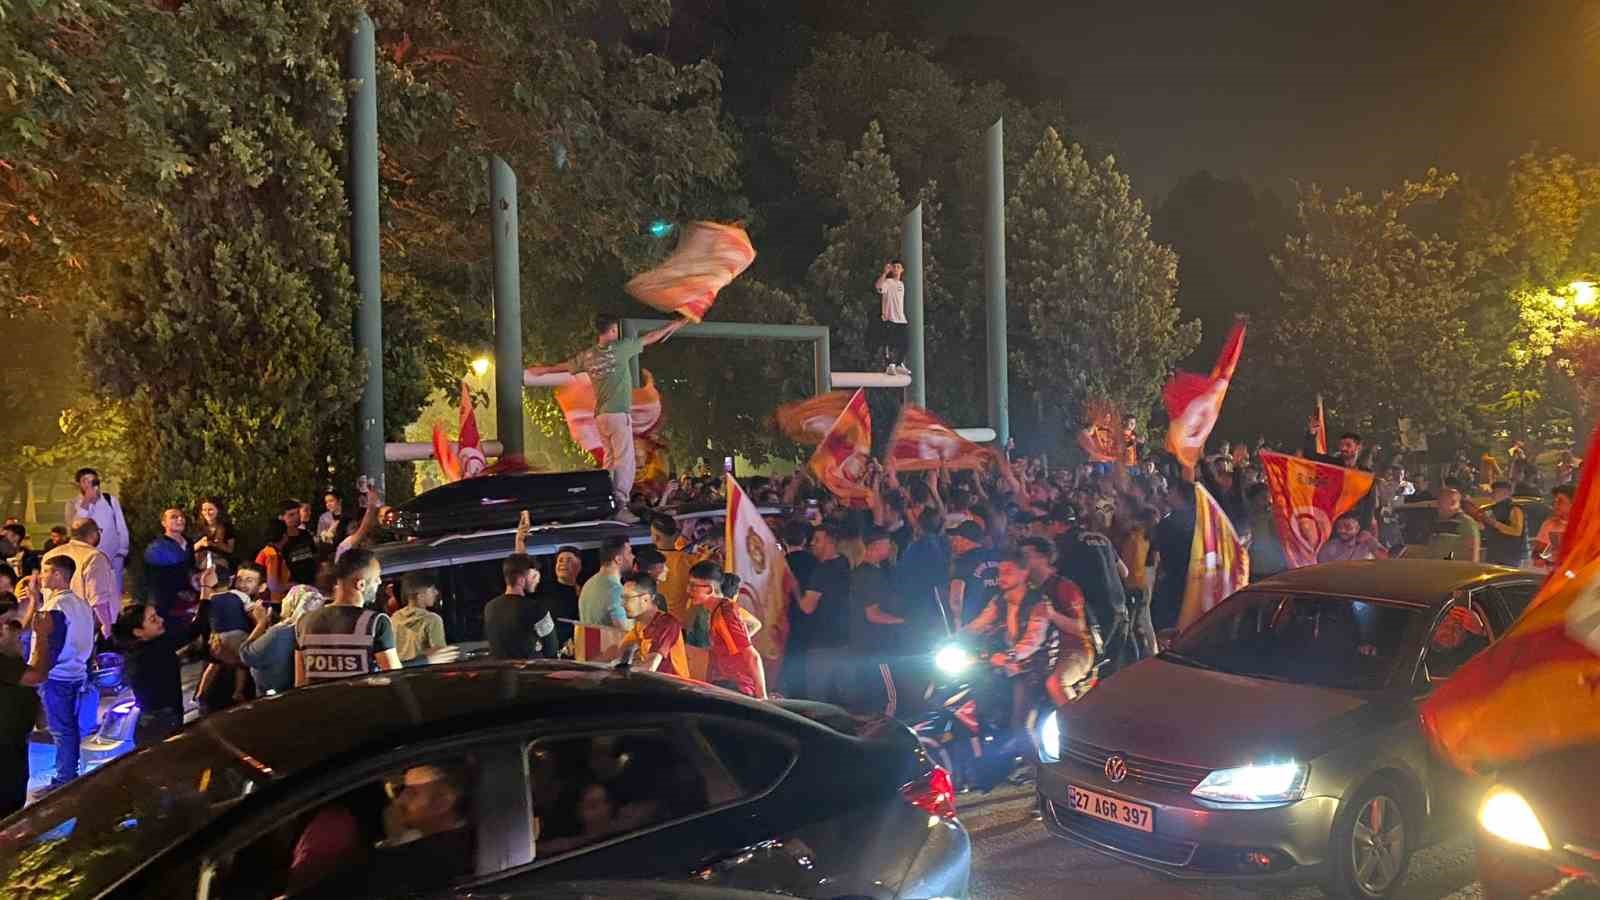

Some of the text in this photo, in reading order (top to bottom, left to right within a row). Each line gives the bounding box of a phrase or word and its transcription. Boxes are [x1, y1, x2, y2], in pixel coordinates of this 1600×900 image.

[1076, 791, 1148, 827] 27 AGR 397
